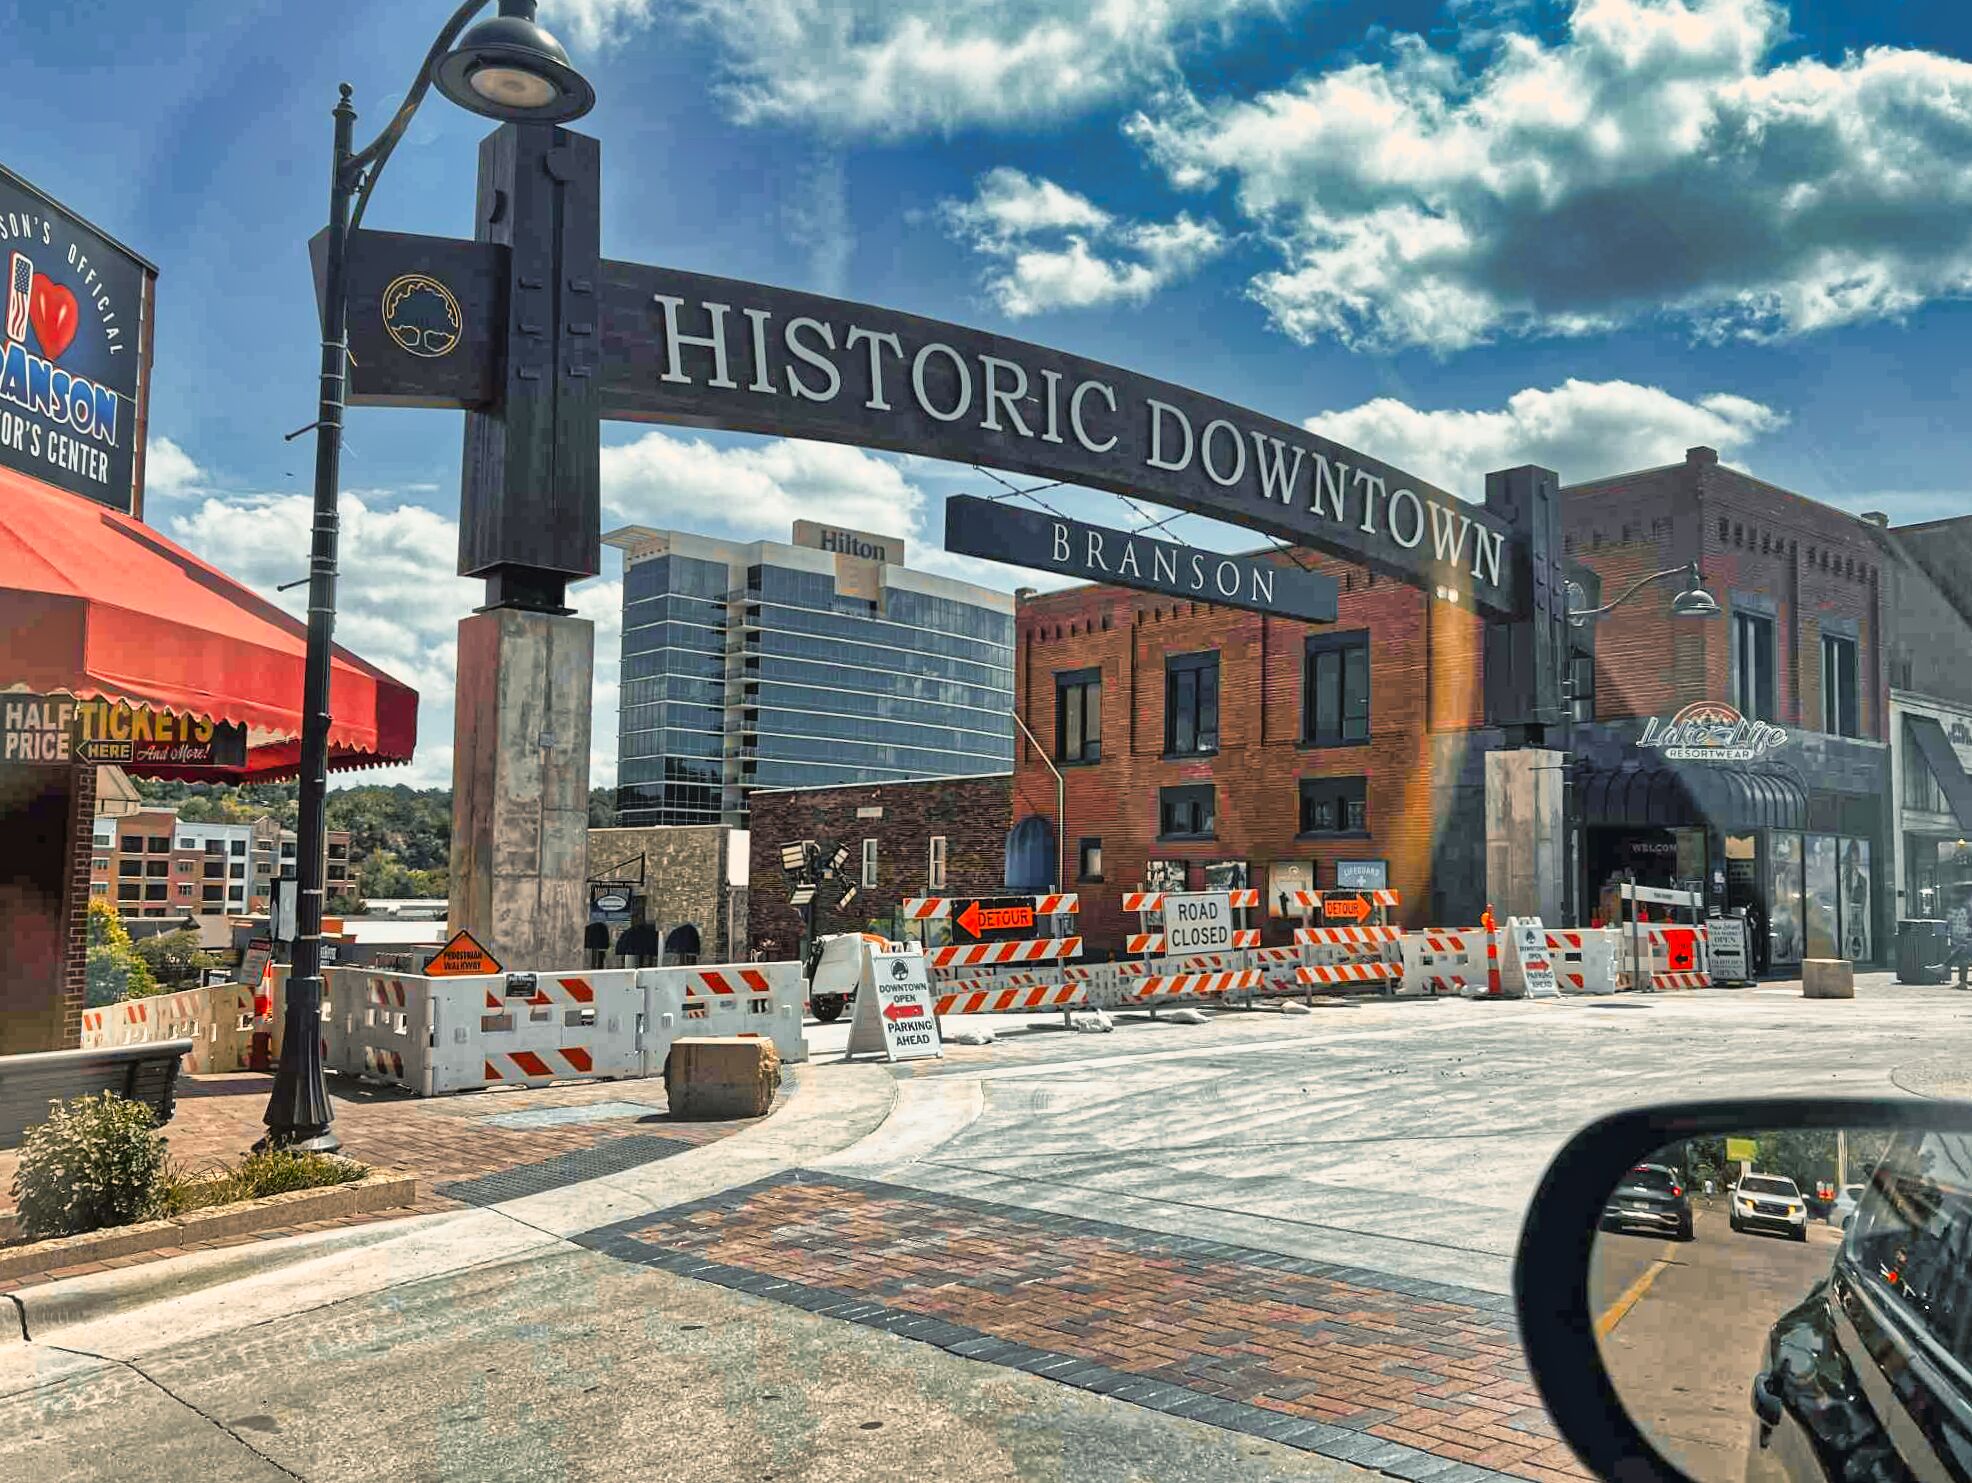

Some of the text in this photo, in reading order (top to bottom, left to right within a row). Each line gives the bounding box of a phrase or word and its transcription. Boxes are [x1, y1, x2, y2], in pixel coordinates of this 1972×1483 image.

[67, 243, 123, 355] OFFICIAL
[0, 340, 118, 446] ANSON
[653, 293, 1505, 588] HISTORIC DOWNTOWN
[47, 431, 108, 484] CENTER
[821, 529, 885, 561] Hilton
[1051, 522, 1276, 604] BRANSON
[5, 702, 73, 730] HALF
[79, 702, 214, 742] TICKETS
[5, 732, 69, 760] PRICE
[88, 744, 130, 758] HERE
[136, 743, 212, 762] And More!
[1669, 749, 1749, 758] RESORTWEAR
[1343, 866, 1380, 877] LIFEGUARD
[978, 909, 1028, 927] DETOUR
[1178, 902, 1218, 921] ROAD
[1326, 902, 1359, 915] DETOUR
[1172, 926, 1228, 947] CLOSED
[443, 950, 483, 960] PEDESTRIAN
[443, 961, 481, 971] WALKWAY
[879, 983, 927, 993] DOWNTOWN
[893, 994, 917, 1003] OPEN
[887, 1020, 933, 1034] PARKING
[896, 1034, 931, 1046] AHEAD
